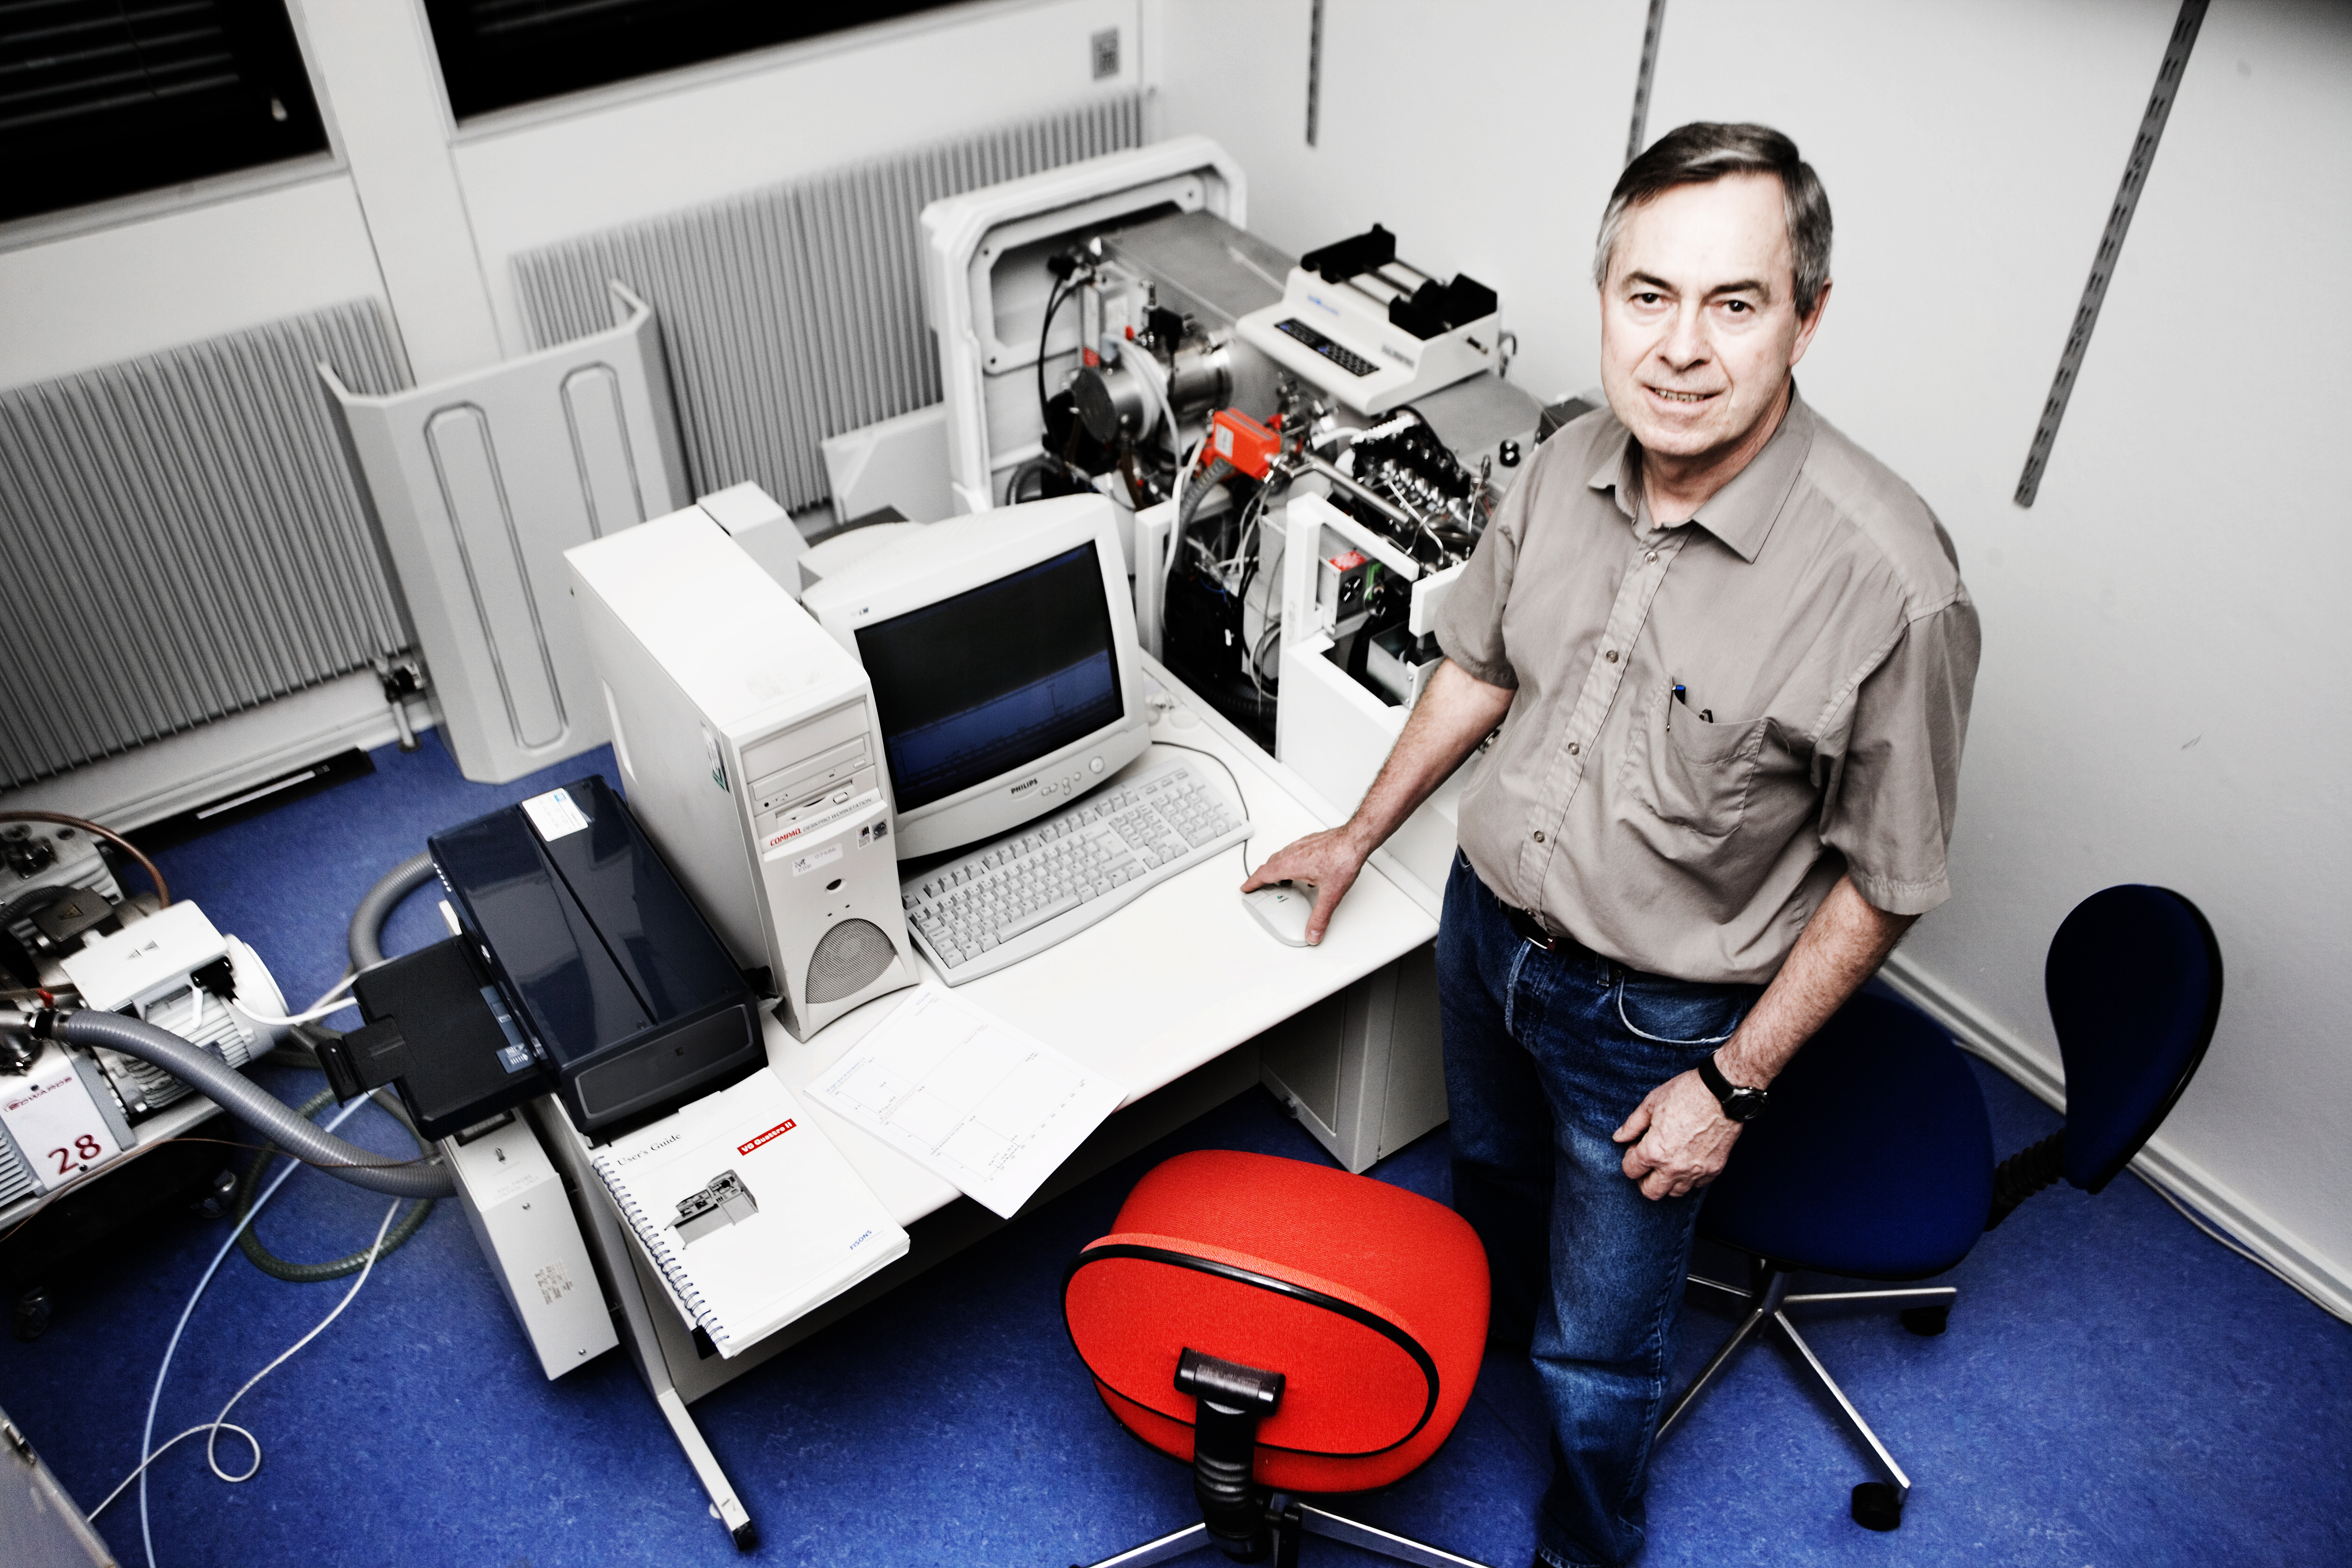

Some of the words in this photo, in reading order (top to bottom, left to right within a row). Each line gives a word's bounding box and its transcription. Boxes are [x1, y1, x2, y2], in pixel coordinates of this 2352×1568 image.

[1011, 778, 1037, 794] PHILIPS
[770, 828, 801, 846] COMPAQ
[803, 816, 830, 832] DESKPRO
[831, 797, 872, 819] WORKSTATION
[5, 1077, 73, 1111] EDWARDS
[48, 1134, 102, 1175] 28
[617, 1149, 648, 1166] User's
[651, 1133, 681, 1151] Guide
[741, 1143, 754, 1152] VG
[754, 1126, 785, 1145] Quattro
[849, 1230, 872, 1250] FISONS
